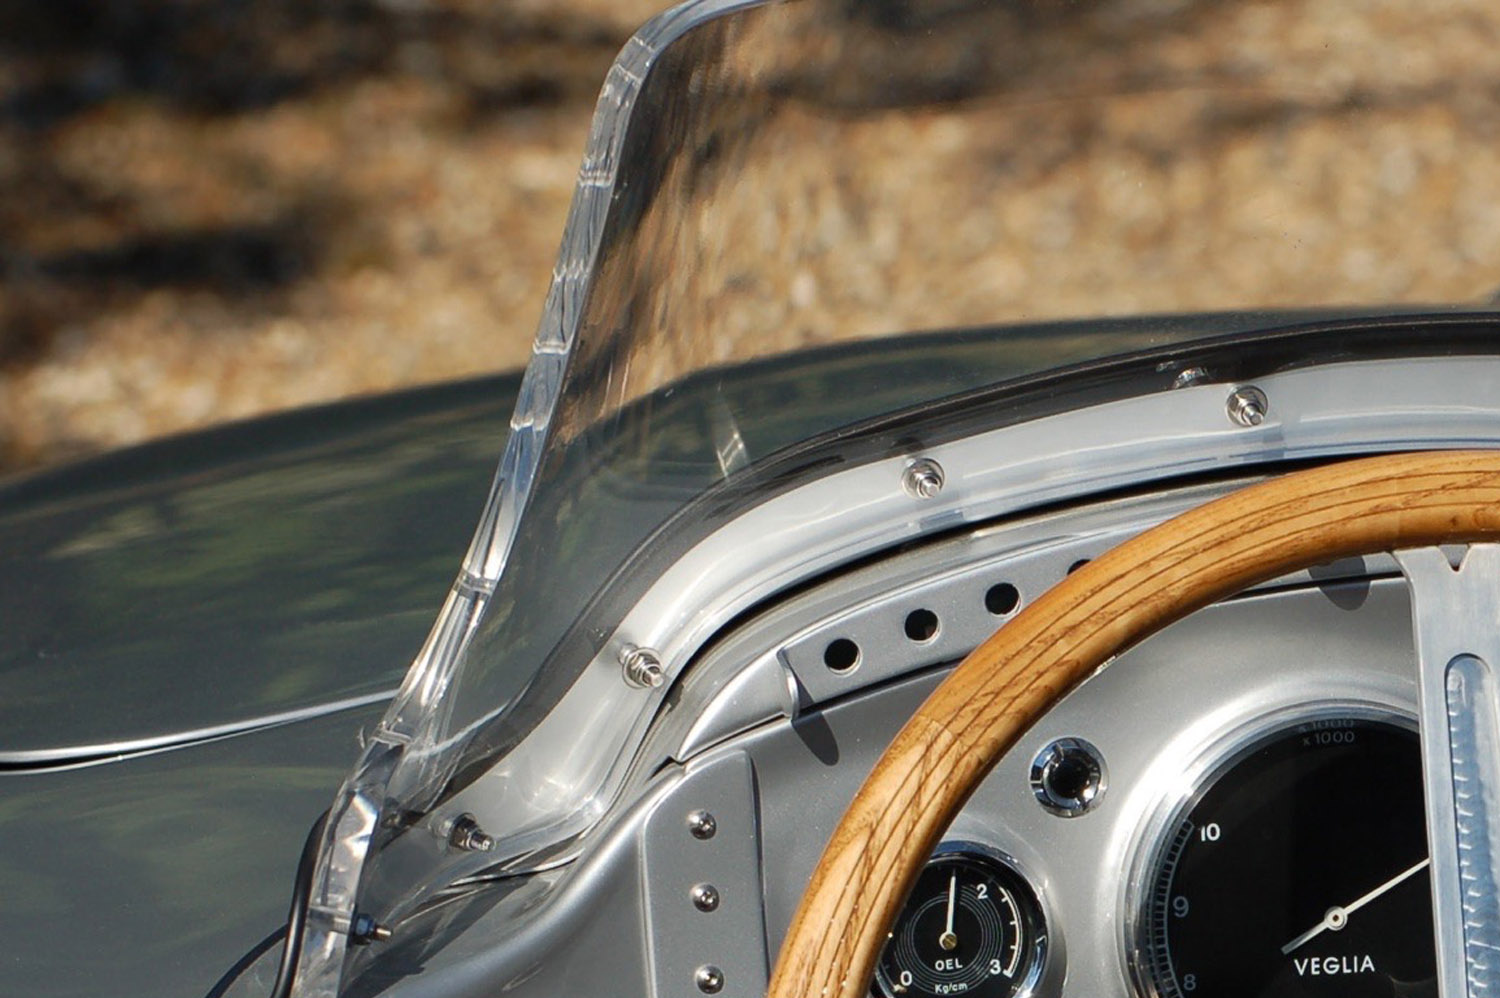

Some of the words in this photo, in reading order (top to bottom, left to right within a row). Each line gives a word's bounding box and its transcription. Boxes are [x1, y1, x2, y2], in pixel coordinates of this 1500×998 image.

[1315, 730, 1356, 745] 1000
[1200, 823, 1221, 842] 10
[976, 883, 988, 900] 2
[1173, 897, 1190, 918] 9
[935, 958, 963, 970] OEL
[990, 959, 1001, 975] 3
[1294, 956, 1375, 976] VEGLIA
[900, 971, 913, 987] 0
[1183, 975, 1197, 992] 8
